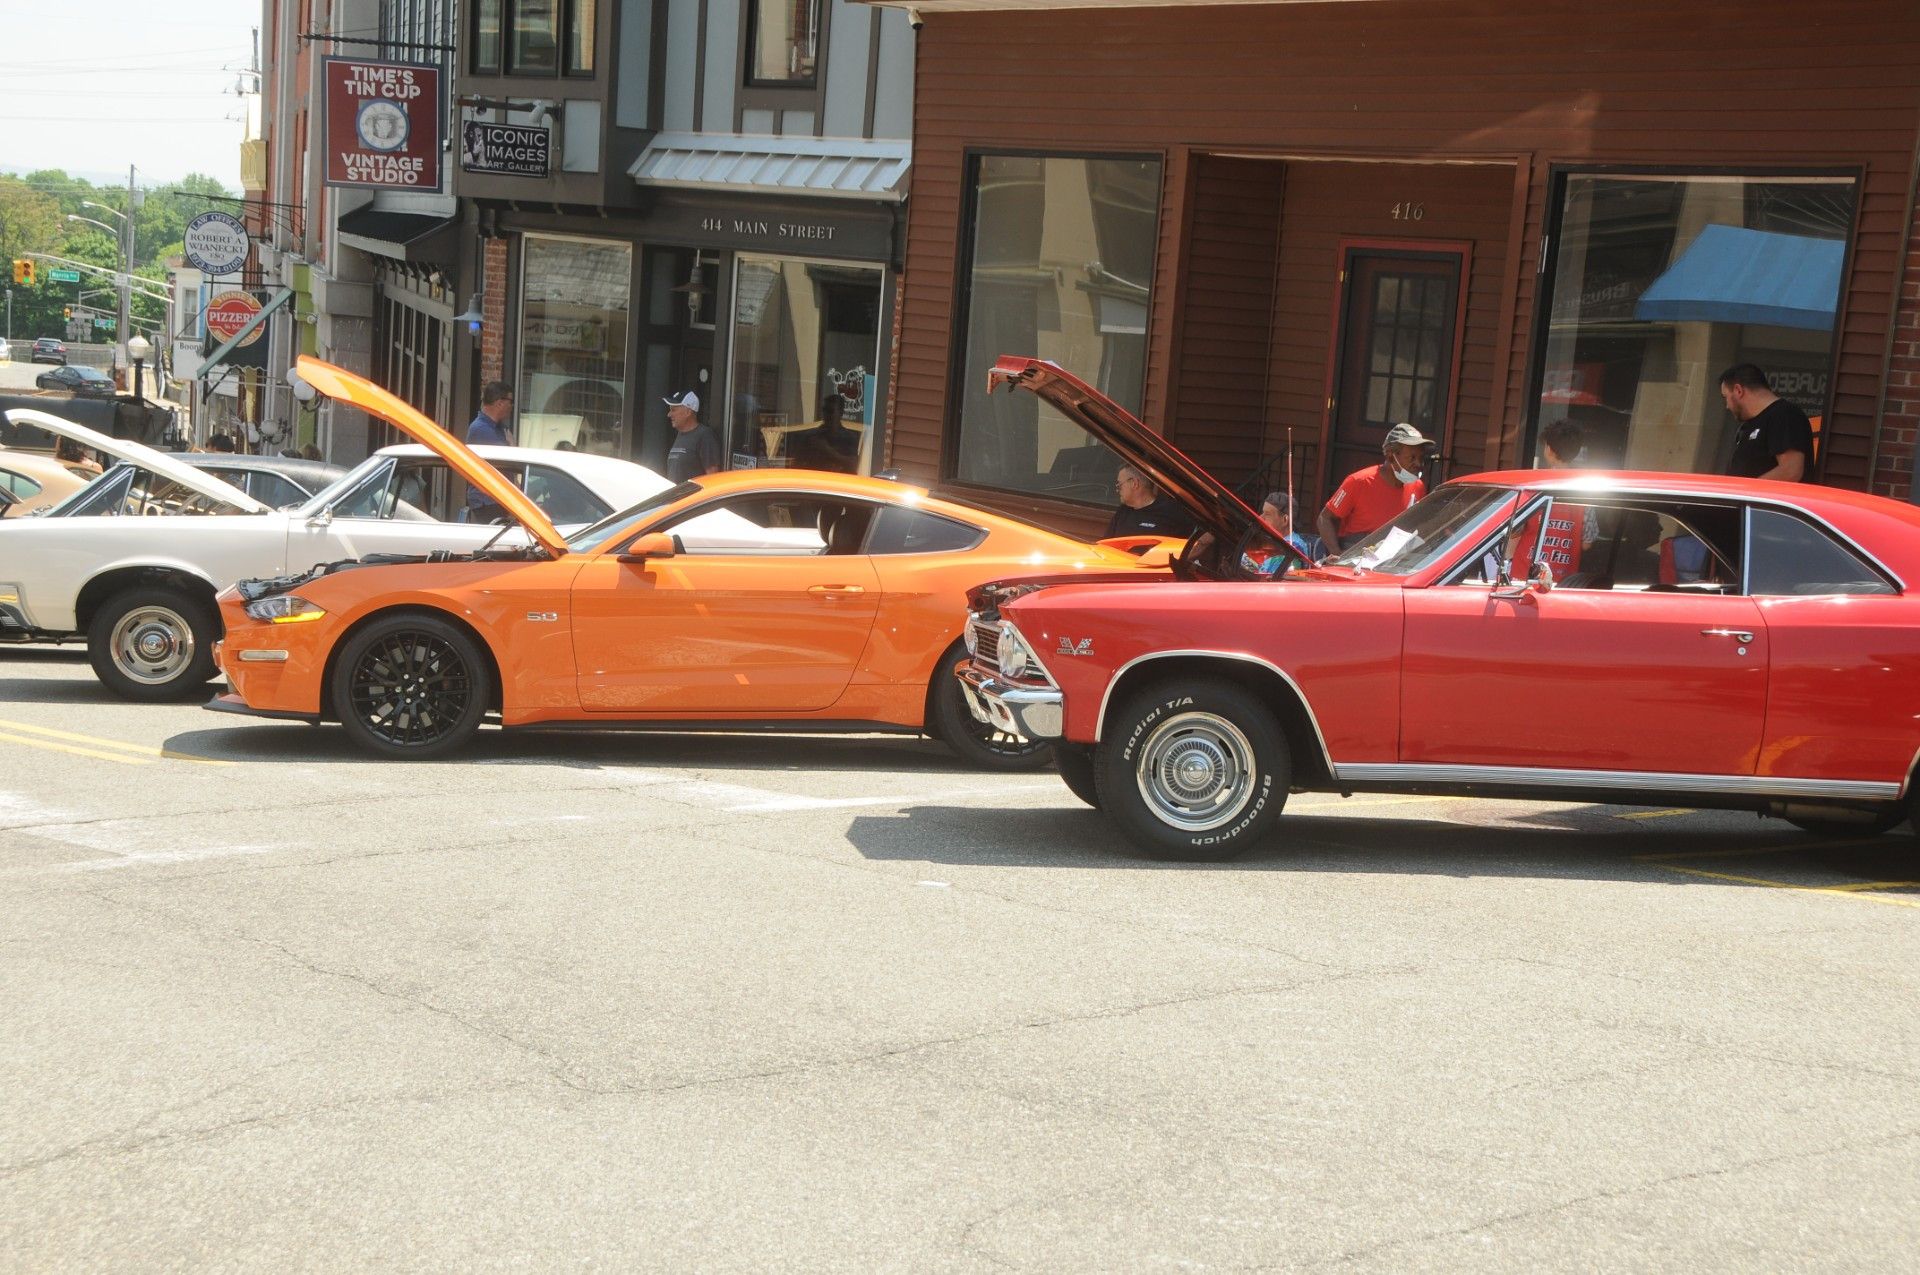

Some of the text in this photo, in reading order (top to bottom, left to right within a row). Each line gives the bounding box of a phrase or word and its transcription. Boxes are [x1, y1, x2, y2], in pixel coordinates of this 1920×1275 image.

[350, 66, 414, 85] TIME'S
[344, 80, 421, 99] TIN CUP
[487, 128, 546, 147] ICONIC
[341, 152, 424, 171] VINTAGE
[486, 145, 546, 162] IMAGES
[347, 167, 418, 184] STUDIO
[1391, 200, 1424, 220] 416
[191, 214, 208, 231] LAW
[701, 218, 836, 240] 414 MAIN STREET
[190, 233, 233, 244] ROBERT
[1123, 696, 1194, 760] Radial T/A
[1191, 774, 1272, 846] BFGoodrich
